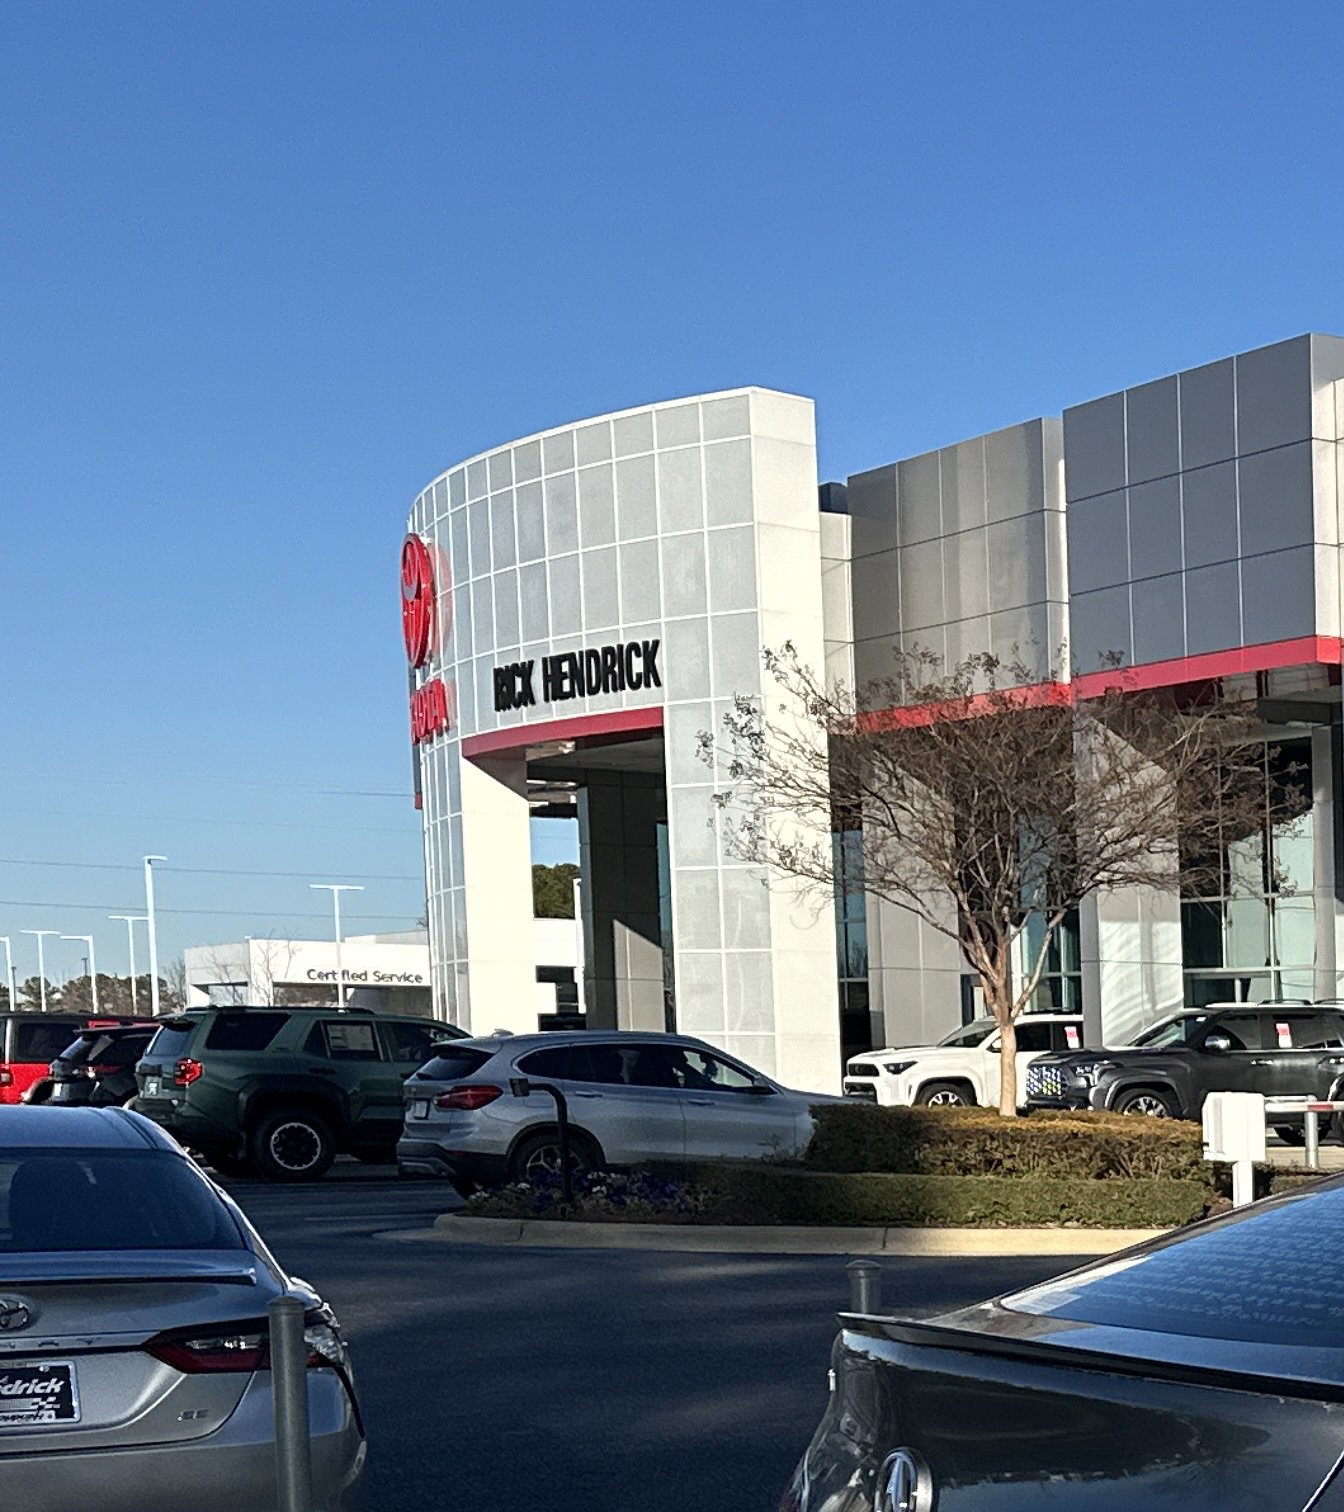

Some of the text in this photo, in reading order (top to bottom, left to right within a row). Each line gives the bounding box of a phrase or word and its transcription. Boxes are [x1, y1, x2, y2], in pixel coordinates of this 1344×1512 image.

[493, 660, 536, 712] RICK
[542, 639, 662, 702] HENDRICK
[306, 968, 423, 983] Certfied Service
[0, 1377, 65, 1395] drick
